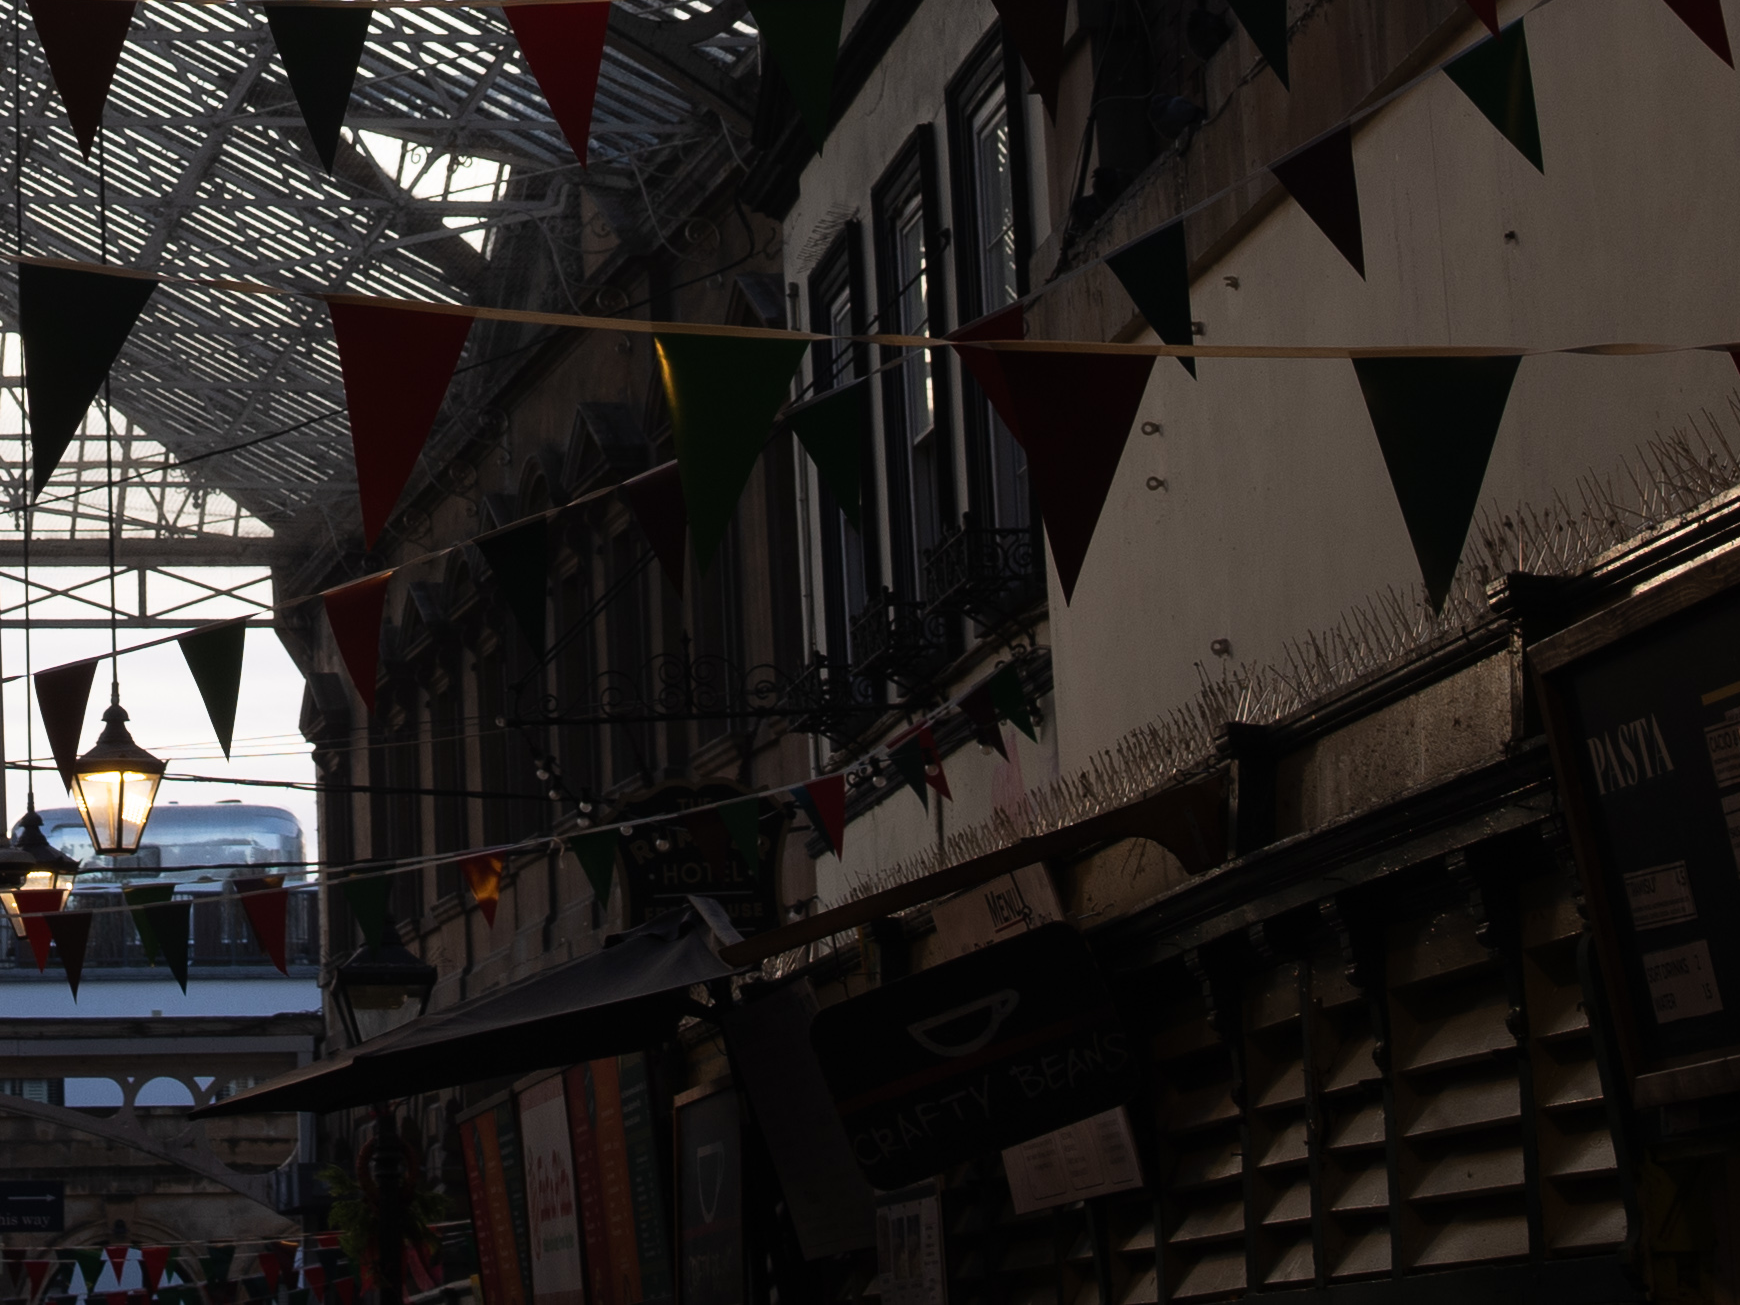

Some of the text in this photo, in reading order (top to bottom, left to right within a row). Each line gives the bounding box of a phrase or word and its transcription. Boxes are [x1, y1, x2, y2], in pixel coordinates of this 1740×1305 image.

[1586, 712, 1675, 796] PASTA
[1707, 730, 1733, 753] CACIO
[662, 860, 745, 885] HOTL
[984, 887, 1023, 928] MENU
[1653, 992, 1677, 1012] WATER
[853, 1074, 990, 1165] CRAFTY
[1009, 1031, 1128, 1099] BEANS
[22, 1215, 51, 1228] way
